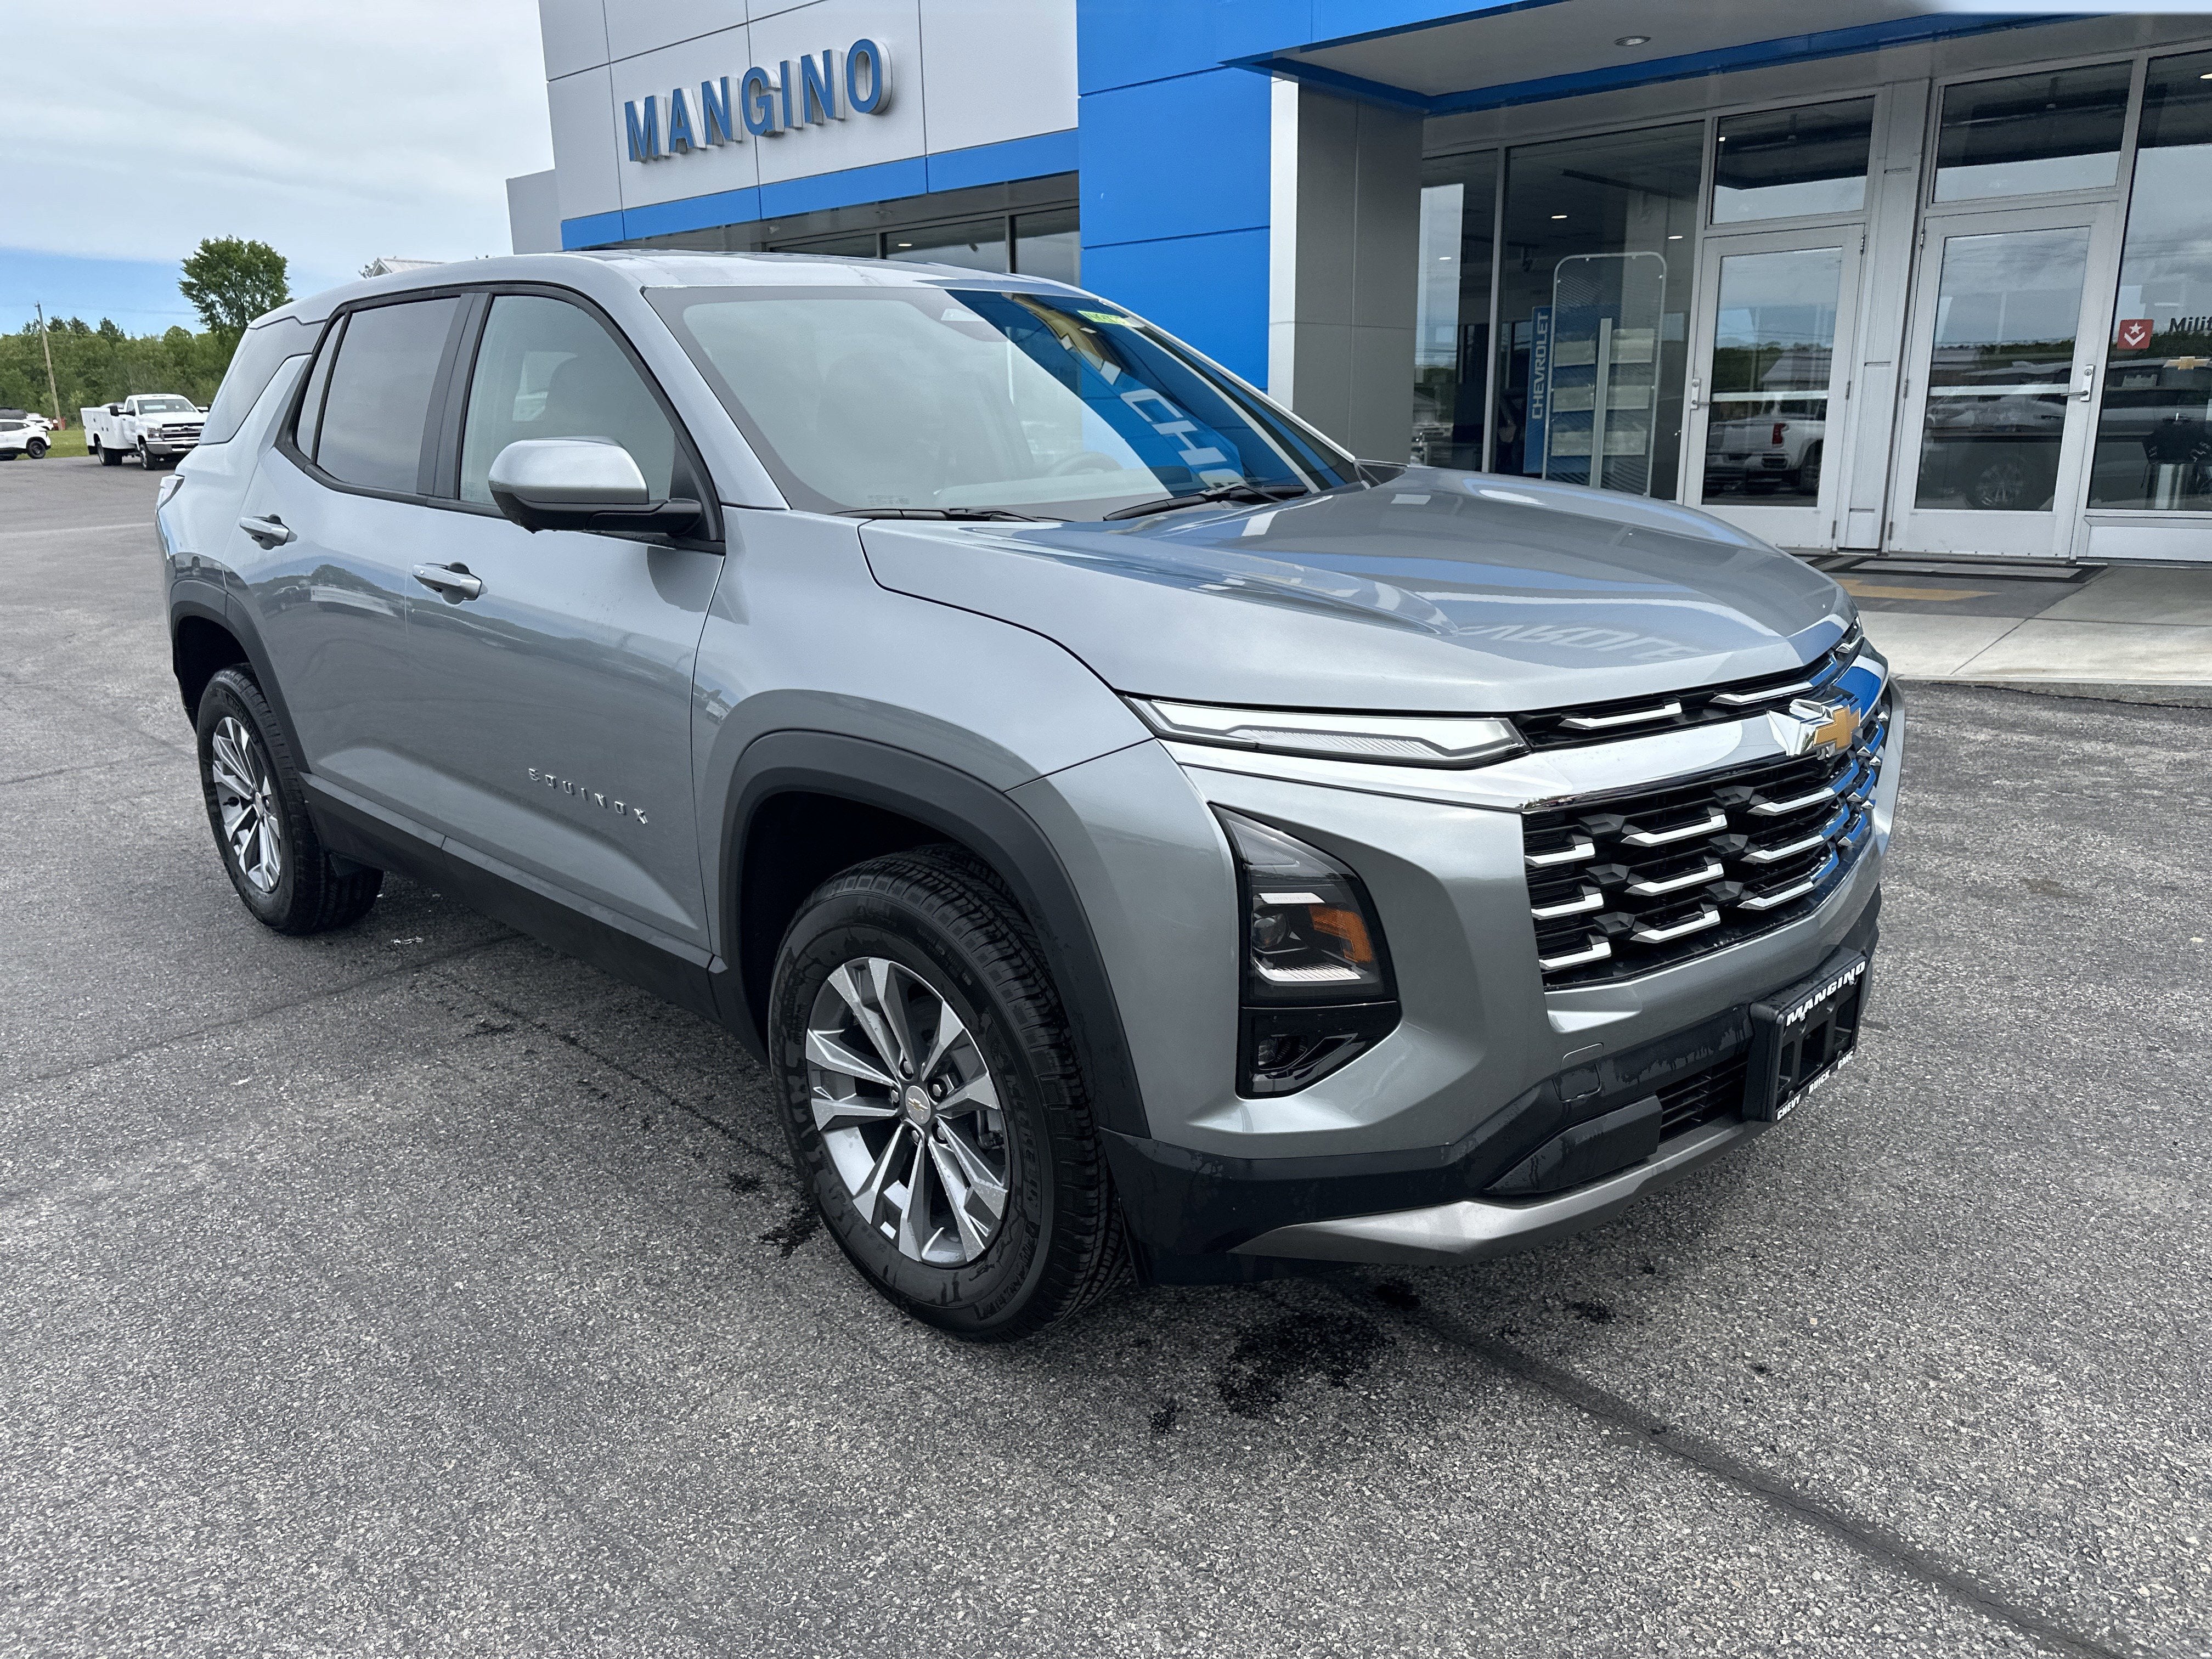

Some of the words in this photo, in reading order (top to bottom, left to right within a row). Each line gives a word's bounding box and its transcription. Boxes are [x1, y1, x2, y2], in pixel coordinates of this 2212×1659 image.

[624, 38, 891, 163] MANGINO
[1532, 312, 1549, 420] CHEVROLET
[528, 768, 648, 825] EQUINOX
[1786, 961, 1866, 1026] MANGINO
[1777, 1094, 1801, 1121] CHEVY
[1808, 1069, 1831, 1094] BUICK
[1837, 1050, 1854, 1070] GMC
